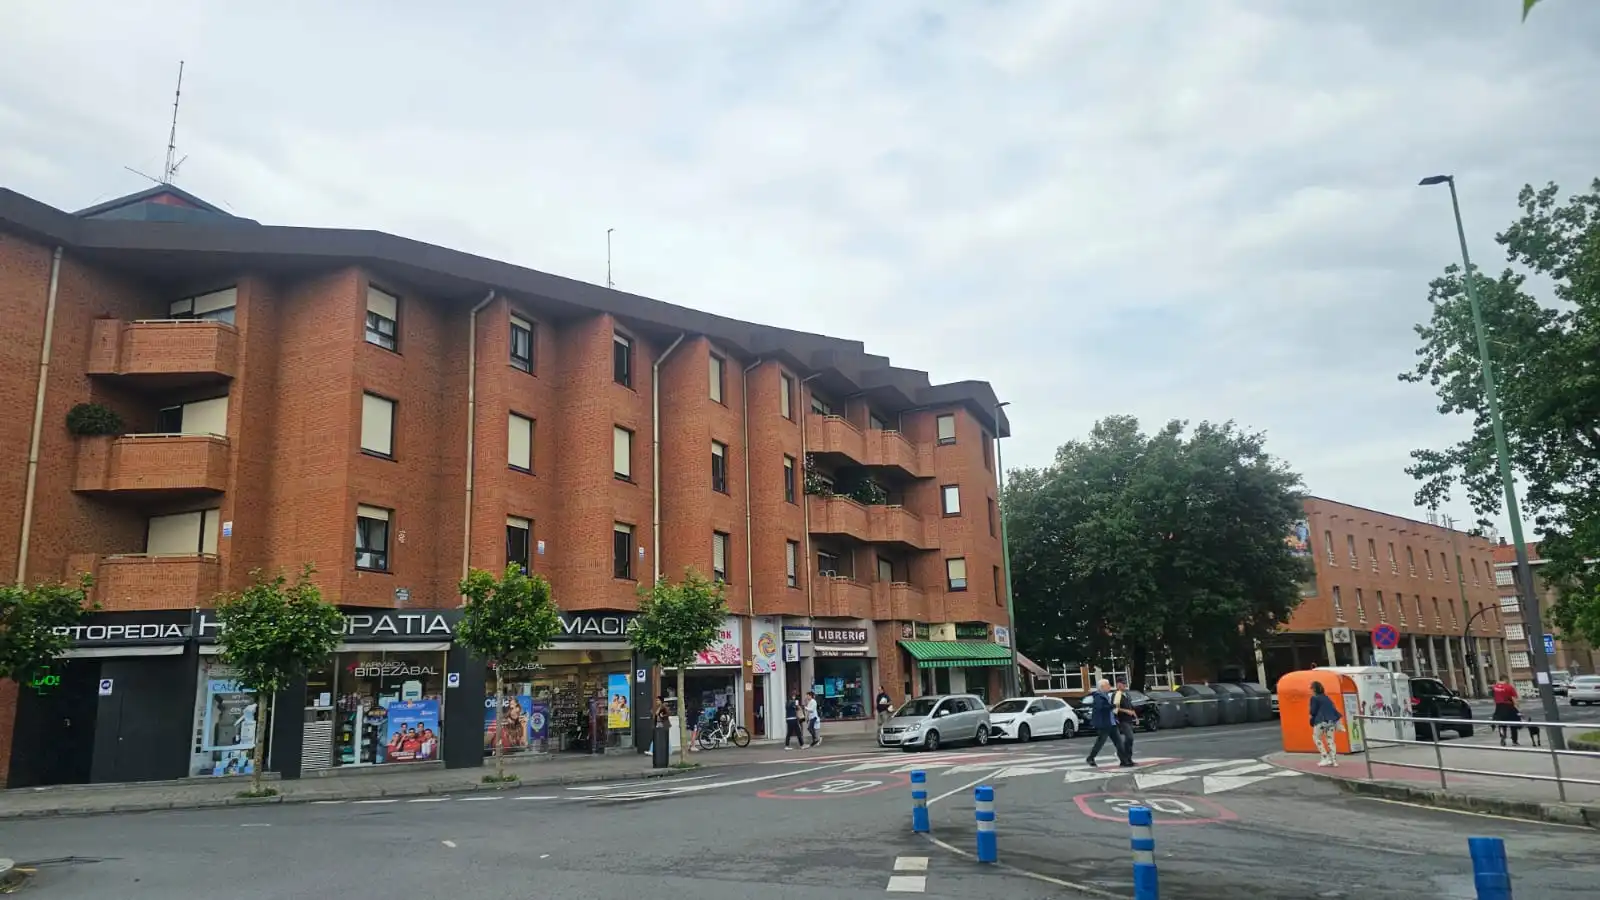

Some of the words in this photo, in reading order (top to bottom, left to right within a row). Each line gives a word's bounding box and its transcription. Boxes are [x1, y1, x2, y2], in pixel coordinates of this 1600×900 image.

[51, 623, 183, 640] RTOPEDIA
[199, 614, 452, 636] HOPATIA
[818, 630, 865, 641] LIBRERIA
[354, 666, 439, 677] BIDEZABAL
[794, 780, 883, 793] 30
[1104, 799, 1195, 814] 30
